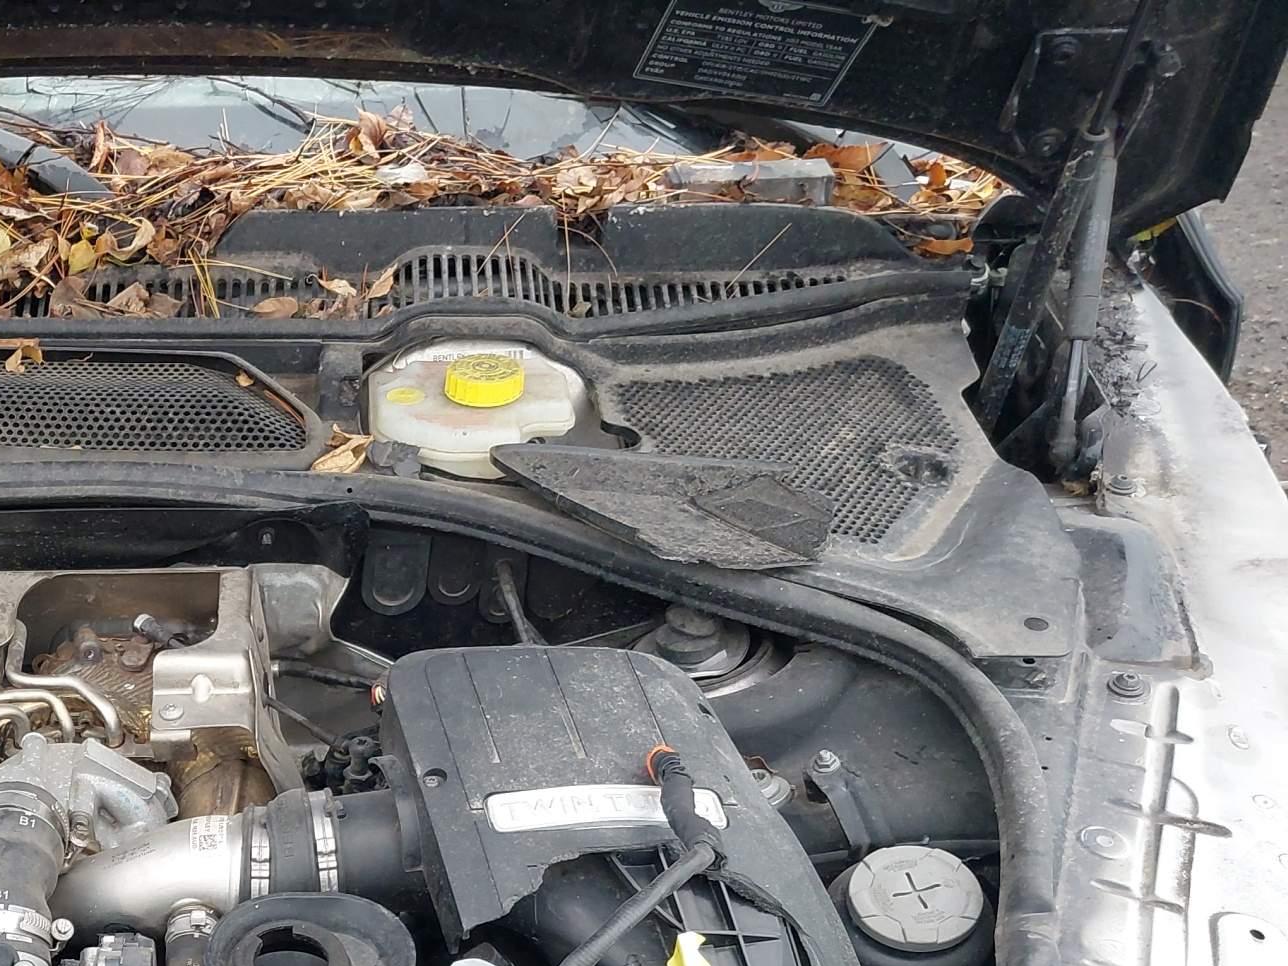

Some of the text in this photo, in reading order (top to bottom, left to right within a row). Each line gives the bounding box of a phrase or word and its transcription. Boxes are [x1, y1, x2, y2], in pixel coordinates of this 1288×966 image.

[675, 10, 859, 44] VEHICLE EMISSION CONTROL INFORMATION
[718, 7, 823, 30] BENTLEY MOTORS LIMITED
[670, 19, 713, 30] CONFORMS
[726, 28, 782, 42] REGULATIONS
[661, 35, 707, 47] CALIFORNIA
[784, 54, 802, 63] FUEL
[789, 47, 808, 55] FUEL
[500, 794, 599, 821] TWIN
[19, 815, 36, 829] B1
